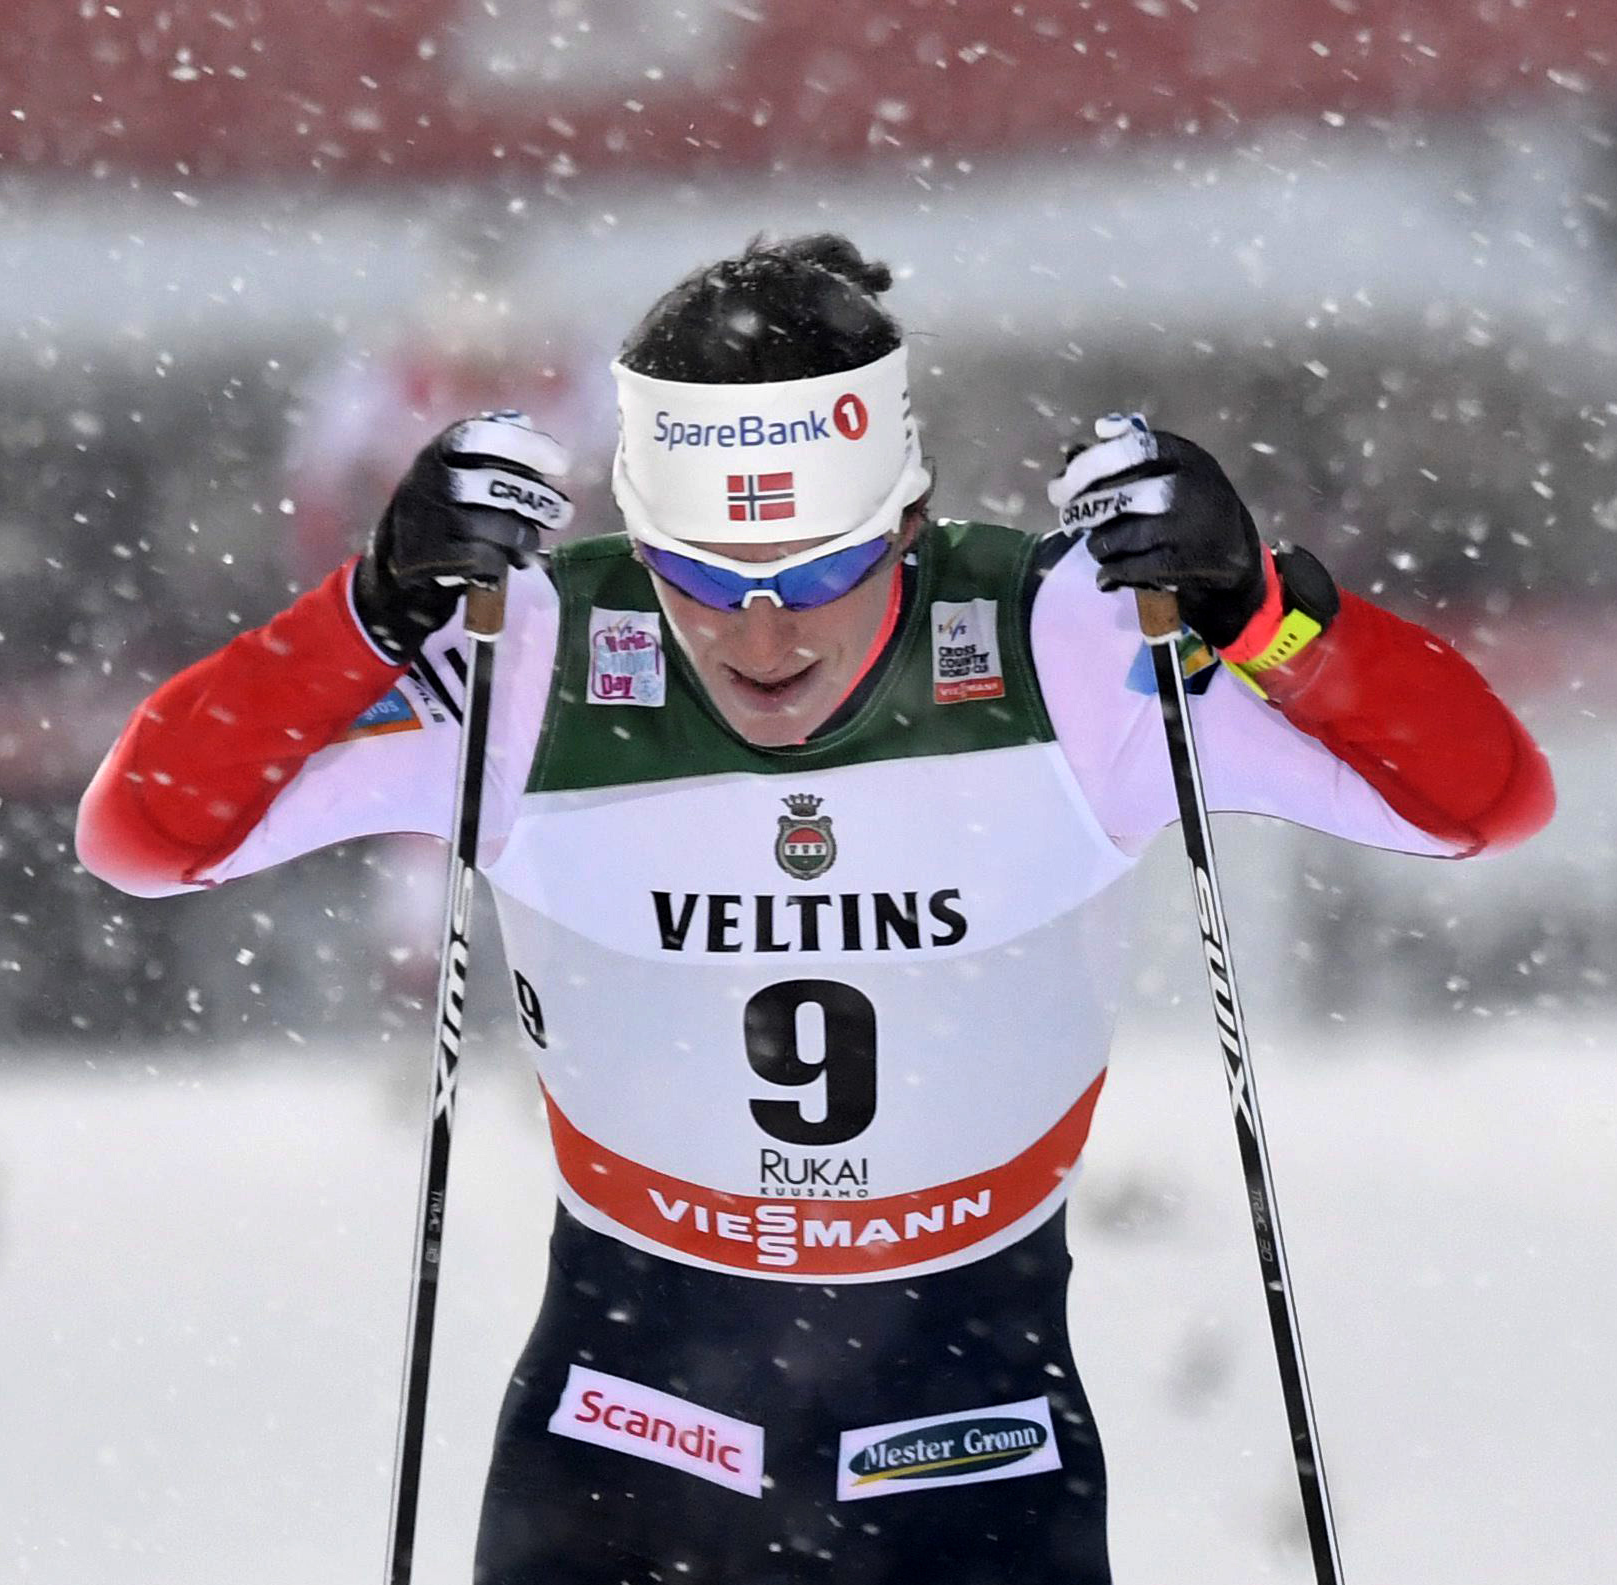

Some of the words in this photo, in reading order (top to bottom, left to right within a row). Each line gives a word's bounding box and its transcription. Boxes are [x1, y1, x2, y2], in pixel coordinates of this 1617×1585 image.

[654, 410, 830, 451] SpareBank
[1064, 496, 1115, 525] CRAFT
[600, 673, 633, 697] Day
[650, 888, 968, 953] VELTINS
[434, 860, 475, 1137] SWIX
[512, 968, 547, 1050] 9
[1189, 857, 1256, 1138] SWIX
[743, 978, 878, 1146] 9
[760, 1148, 869, 1186] RUKA!
[760, 1187, 869, 1198] KUUSAMO
[647, 1188, 992, 1266] VIESSMANN
[575, 1390, 741, 1474] Scandic
[863, 1437, 955, 1471] Mester
